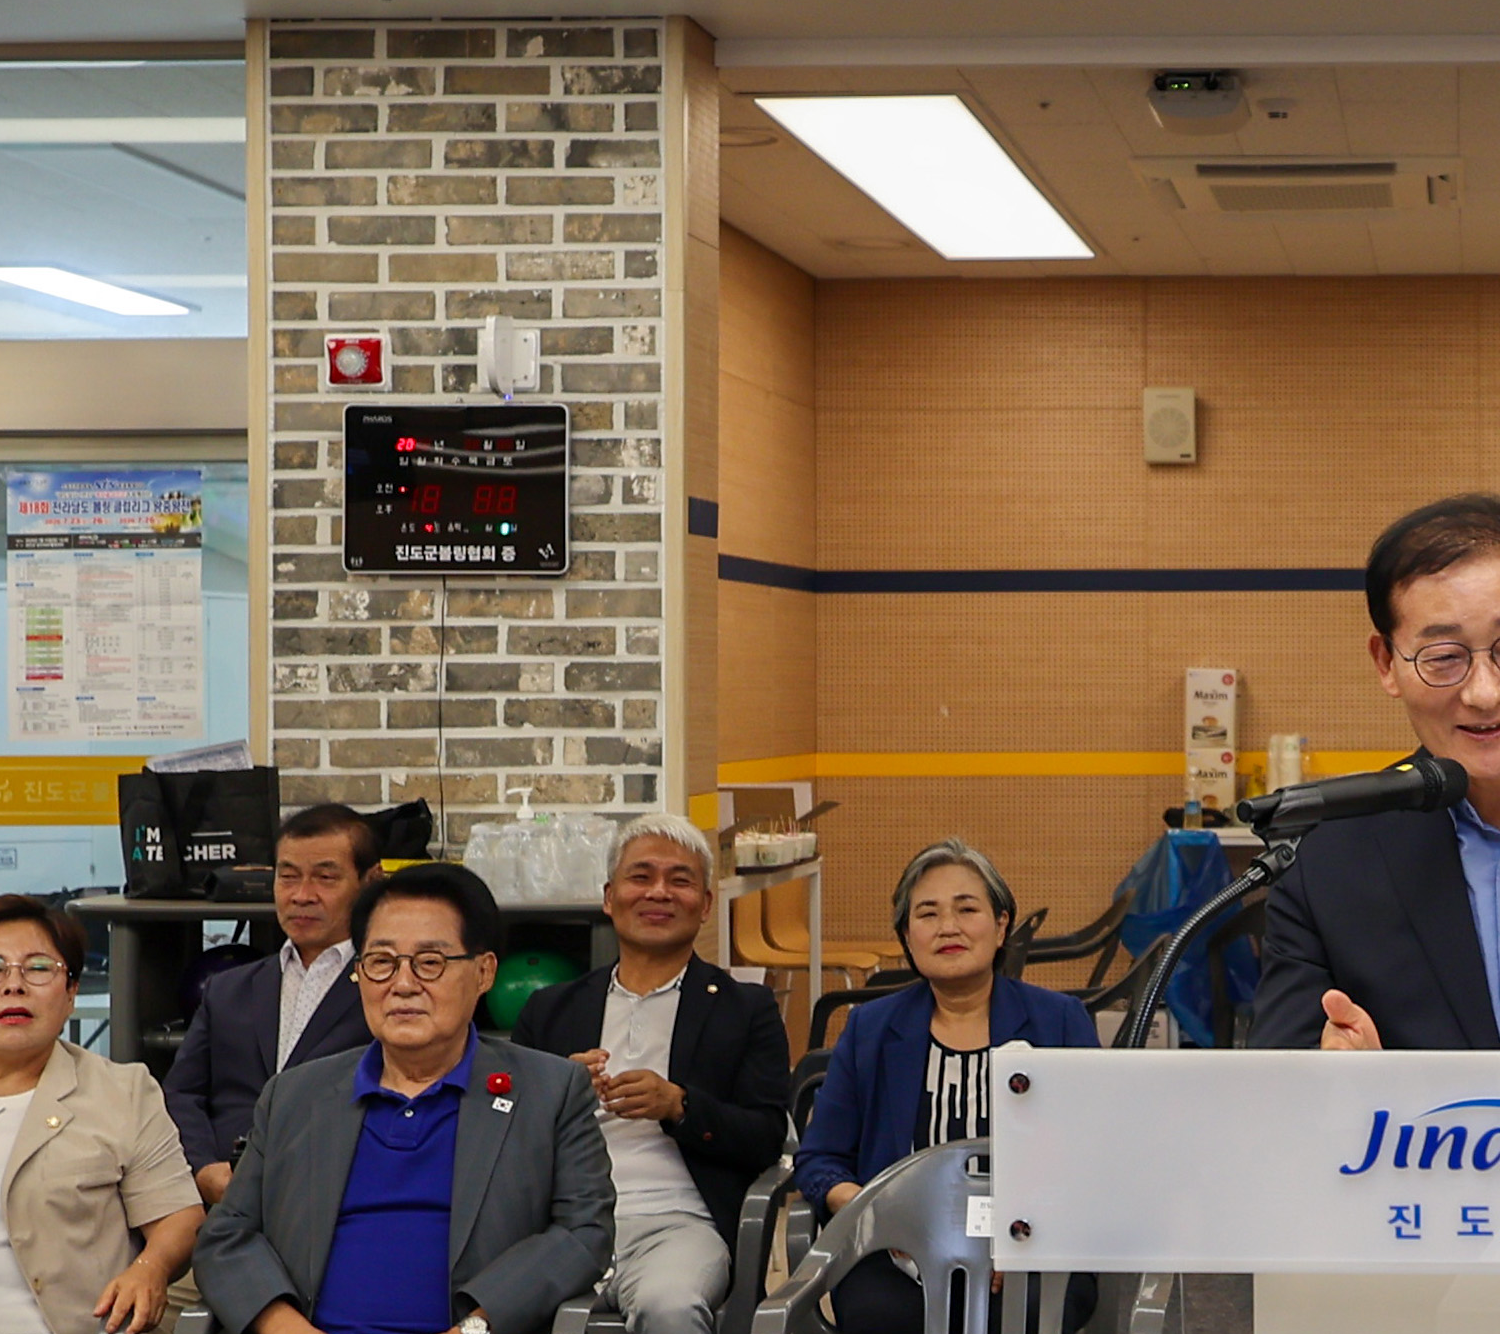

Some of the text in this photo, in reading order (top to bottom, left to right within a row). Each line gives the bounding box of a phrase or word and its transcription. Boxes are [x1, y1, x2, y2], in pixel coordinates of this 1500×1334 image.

[19, 500, 50, 515] 제18회
[52, 500, 89, 515] 전라남도
[93, 500, 111, 515] 볼링
[395, 544, 516, 562] 진도군볼링협회 증
[1194, 690, 1228, 700] Maxim
[135, 825, 161, 843] I'M
